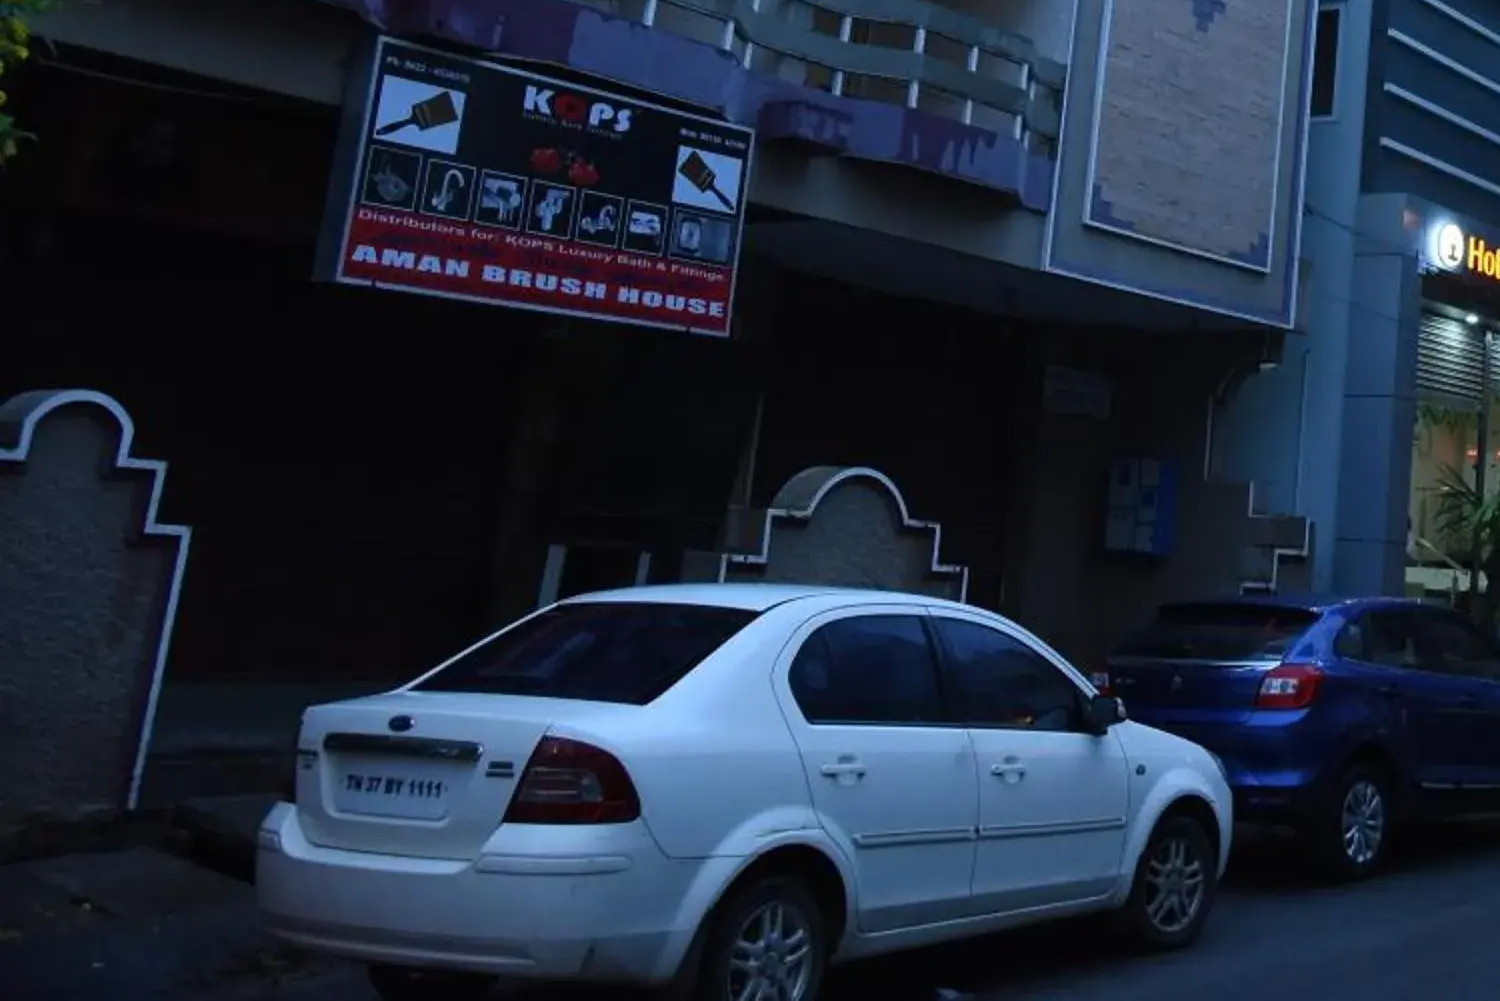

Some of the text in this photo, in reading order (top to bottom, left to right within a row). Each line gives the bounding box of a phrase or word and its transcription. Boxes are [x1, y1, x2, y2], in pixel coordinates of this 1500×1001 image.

[524, 85, 632, 132] KOPS
[358, 208, 465, 237] Distributors
[505, 235, 553, 252] KOPS
[559, 244, 613, 264] Luxury
[617, 255, 652, 270] Bath
[352, 244, 725, 317] AMAN BRUSH HOUSE
[346, 775, 363, 792] TN
[409, 779, 442, 799] 1111
